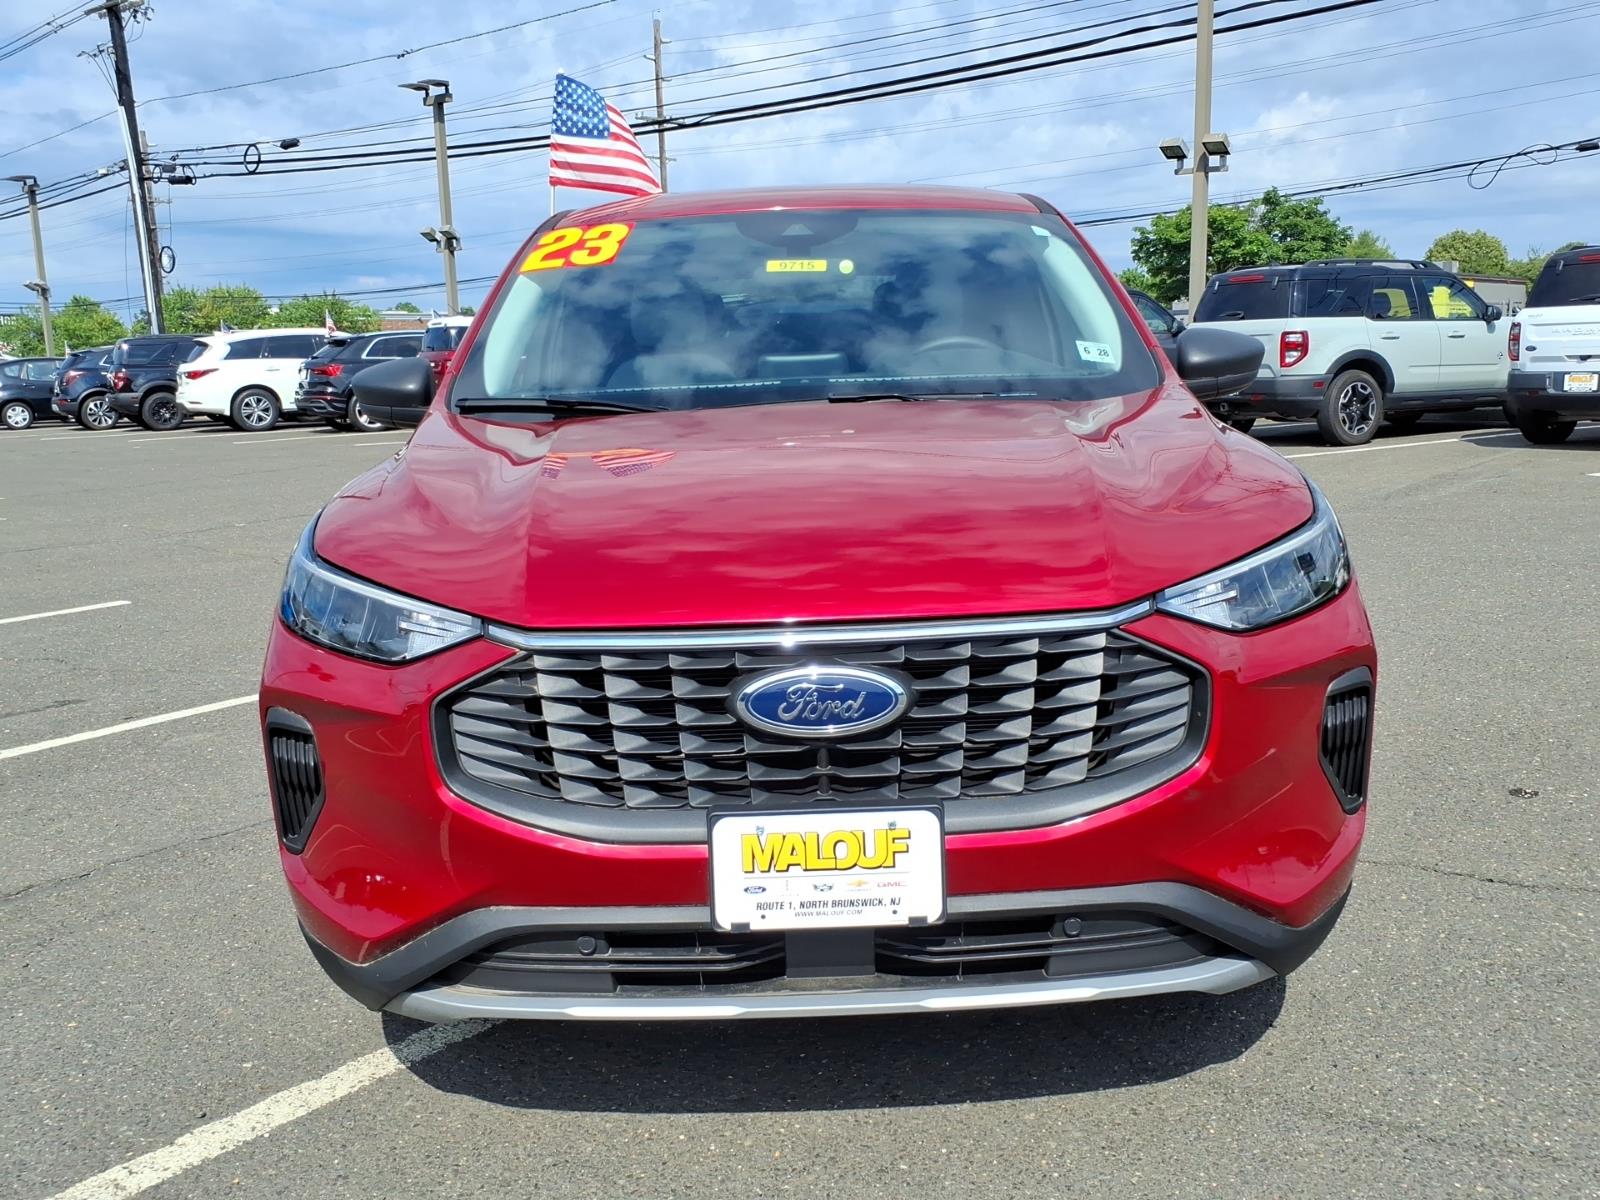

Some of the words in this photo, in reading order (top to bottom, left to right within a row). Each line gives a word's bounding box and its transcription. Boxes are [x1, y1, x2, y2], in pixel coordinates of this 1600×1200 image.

[519, 223, 629, 273] 23
[779, 262, 816, 270] 9715
[1083, 346, 1090, 354] 6
[1097, 348, 1109, 357] 28
[777, 683, 867, 722] Ford
[741, 828, 911, 872] MALOUF
[756, 901, 785, 911] ROUTE
[799, 899, 829, 910] NORTH
[831, 897, 887, 908] BRUNSWICK,
[889, 897, 901, 906] NJ
